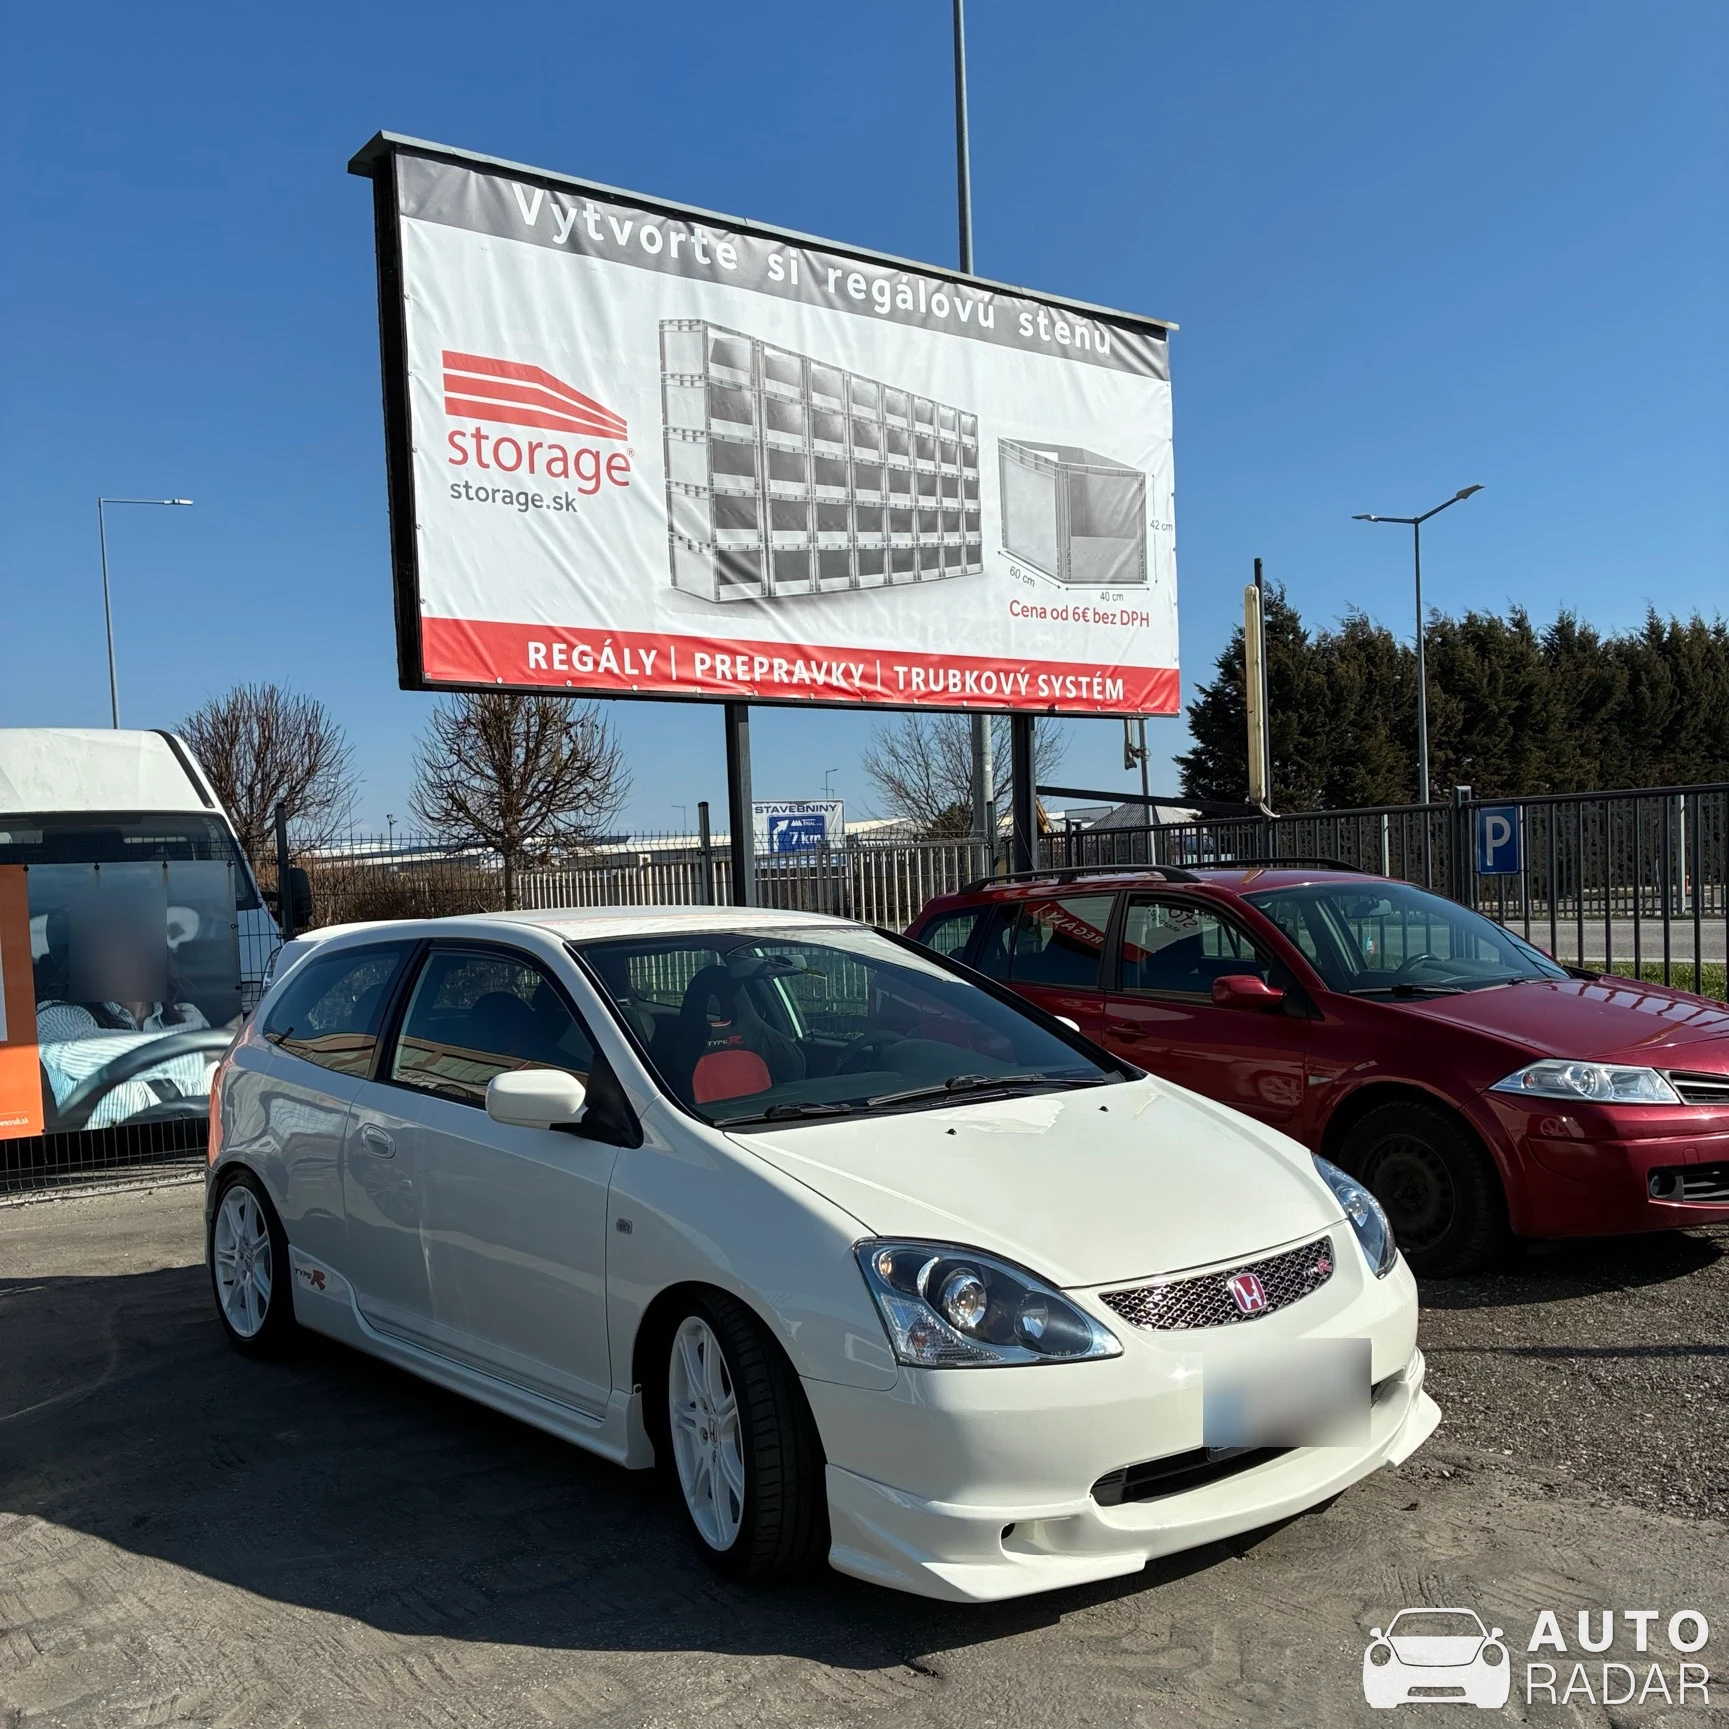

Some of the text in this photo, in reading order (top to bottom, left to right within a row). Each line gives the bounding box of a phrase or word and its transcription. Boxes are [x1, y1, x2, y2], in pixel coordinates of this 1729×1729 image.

[511, 183, 1111, 355] Vytvorte si regálovú stenu
[447, 426, 632, 495] storage
[449, 480, 578, 513] storage.sk
[1150, 520, 1174, 532] 42 cm
[1009, 565, 1036, 588] 60 cm
[1100, 591, 1124, 602] 40 cm
[1009, 599, 1150, 628] Cena od 6€ bez DPH
[527, 638, 1124, 700] REGÁLY PREPRAVKY TRUBKOVÝ SYSTÉM
[754, 804, 838, 814] STAVEBNINY
[789, 831, 821, 845] 7 km
[1485, 815, 1512, 866] P
[707, 1039, 728, 1047] TYPE
[294, 1267, 326, 1291] TYPE R
